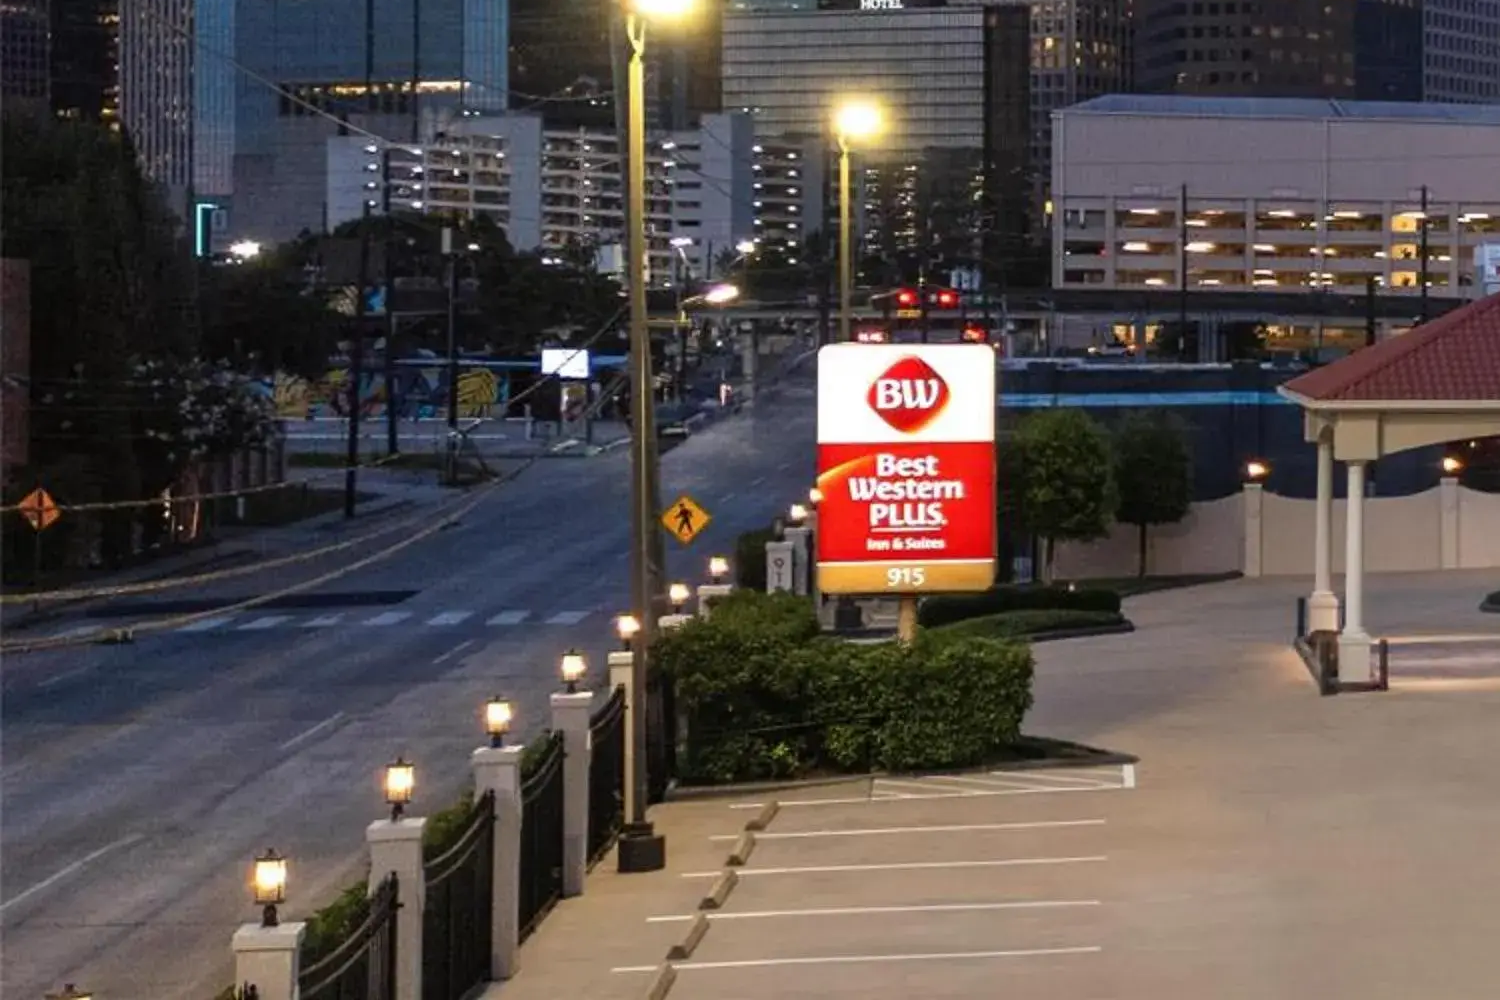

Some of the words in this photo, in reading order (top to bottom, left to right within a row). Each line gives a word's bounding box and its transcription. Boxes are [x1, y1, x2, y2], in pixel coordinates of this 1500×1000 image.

[876, 379, 939, 409] BW
[876, 453, 939, 476] Best
[848, 477, 964, 501] Western
[866, 538, 890, 551] Inn
[891, 537, 904, 551] &
[904, 536, 946, 551] Suites
[887, 567, 925, 587] 915
